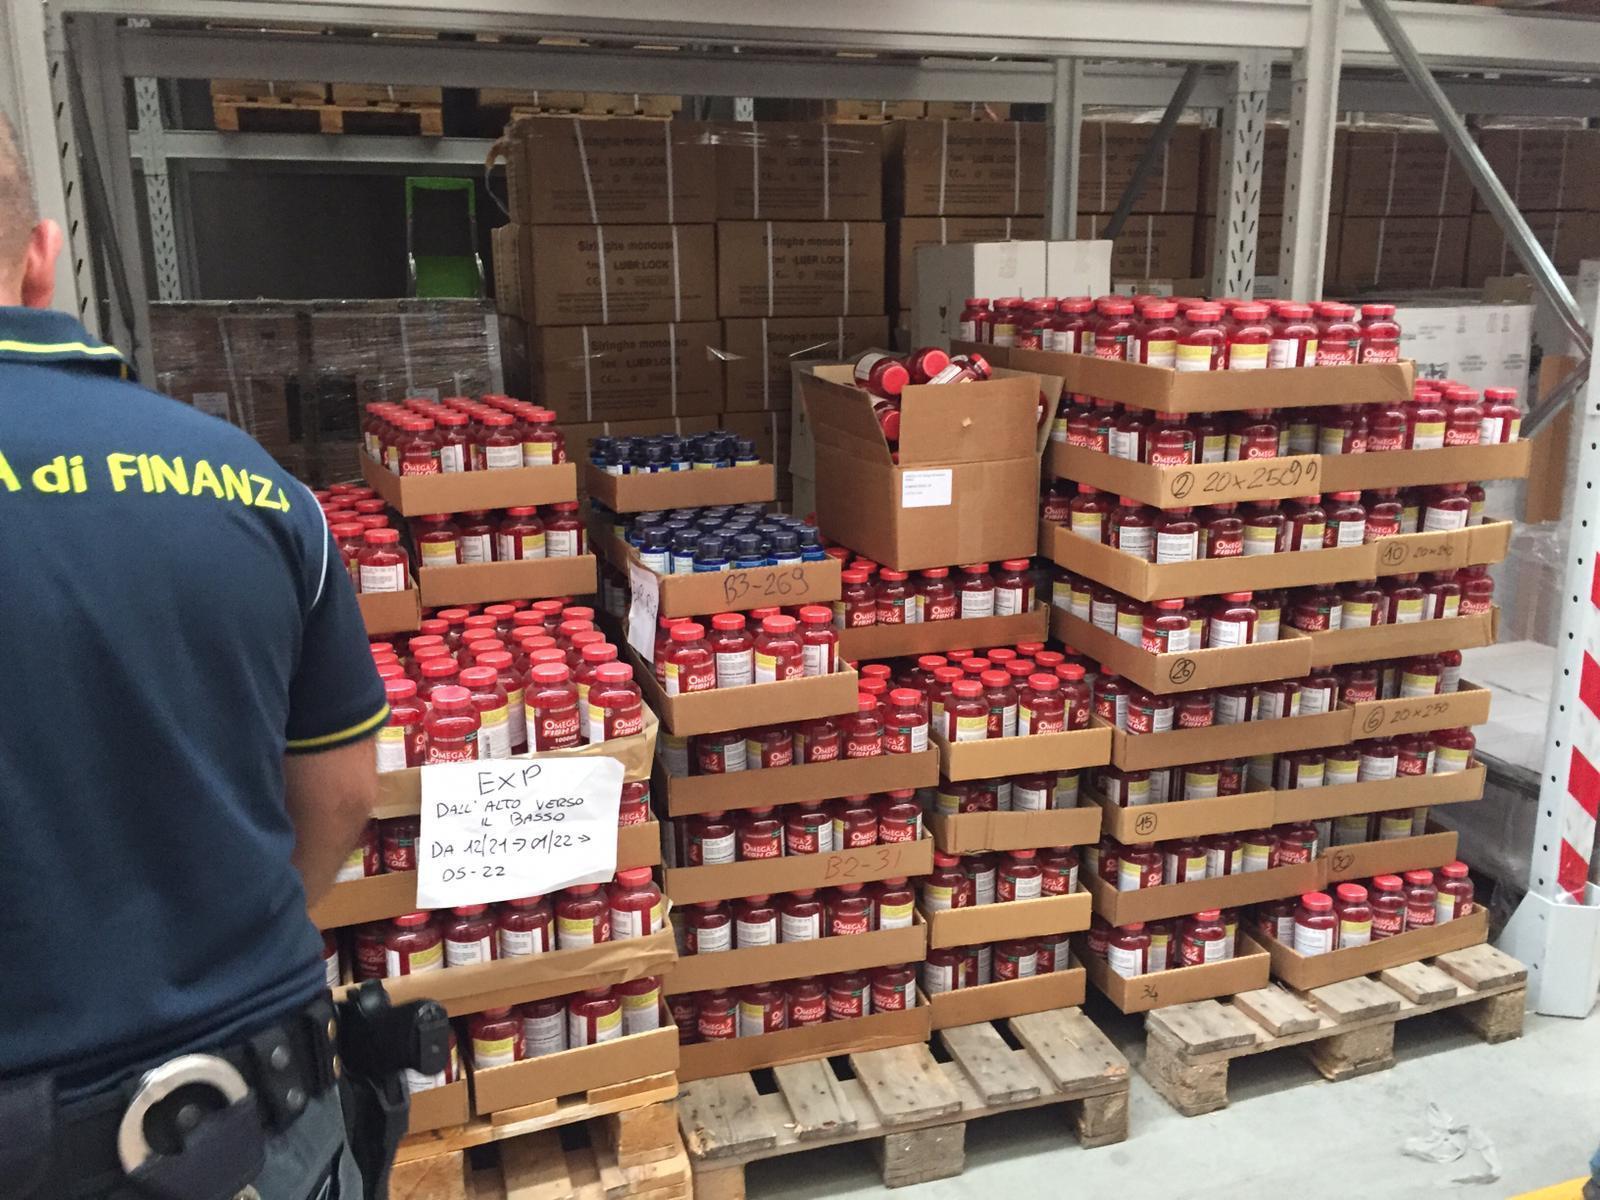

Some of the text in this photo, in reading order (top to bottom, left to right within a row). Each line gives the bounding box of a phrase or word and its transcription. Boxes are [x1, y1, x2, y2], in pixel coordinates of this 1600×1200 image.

[32, 455, 87, 494] di
[478, 764, 542, 796] EXP
[484, 799, 521, 812] ALTO
[536, 797, 584, 811] VERSO
[510, 812, 566, 826] BASSO
[431, 842, 454, 859] DA
